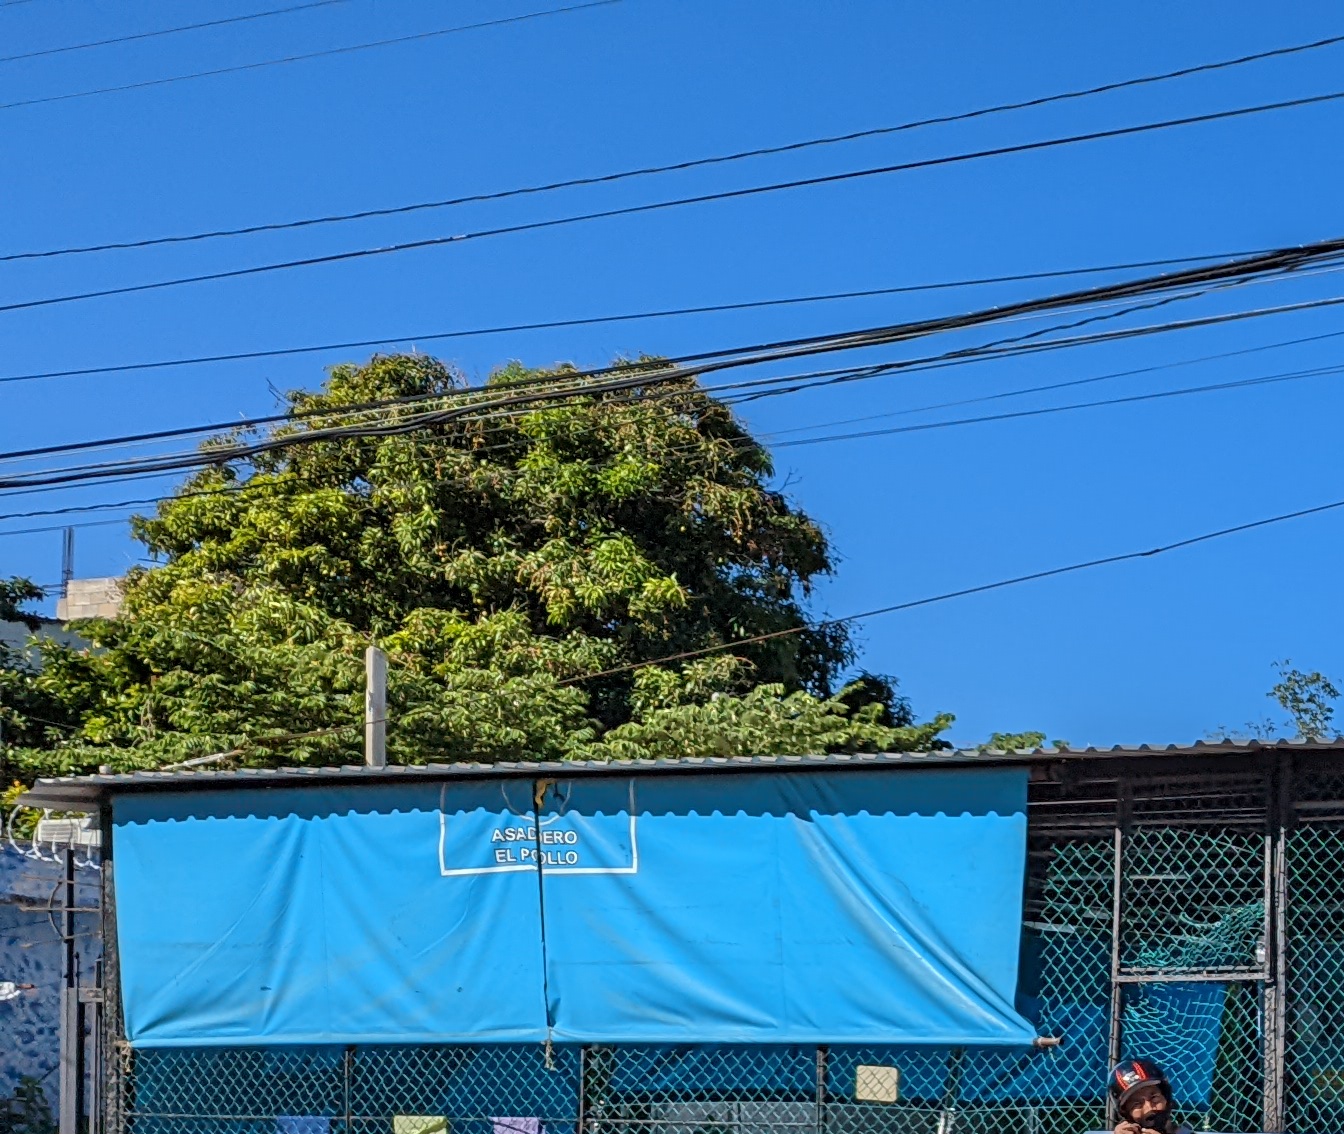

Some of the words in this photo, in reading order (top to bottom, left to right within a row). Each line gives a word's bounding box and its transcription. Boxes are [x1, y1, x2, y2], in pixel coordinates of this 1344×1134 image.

[492, 826, 578, 844] ASADERO
[495, 848, 516, 863] EL
[520, 847, 578, 865] POLLO
